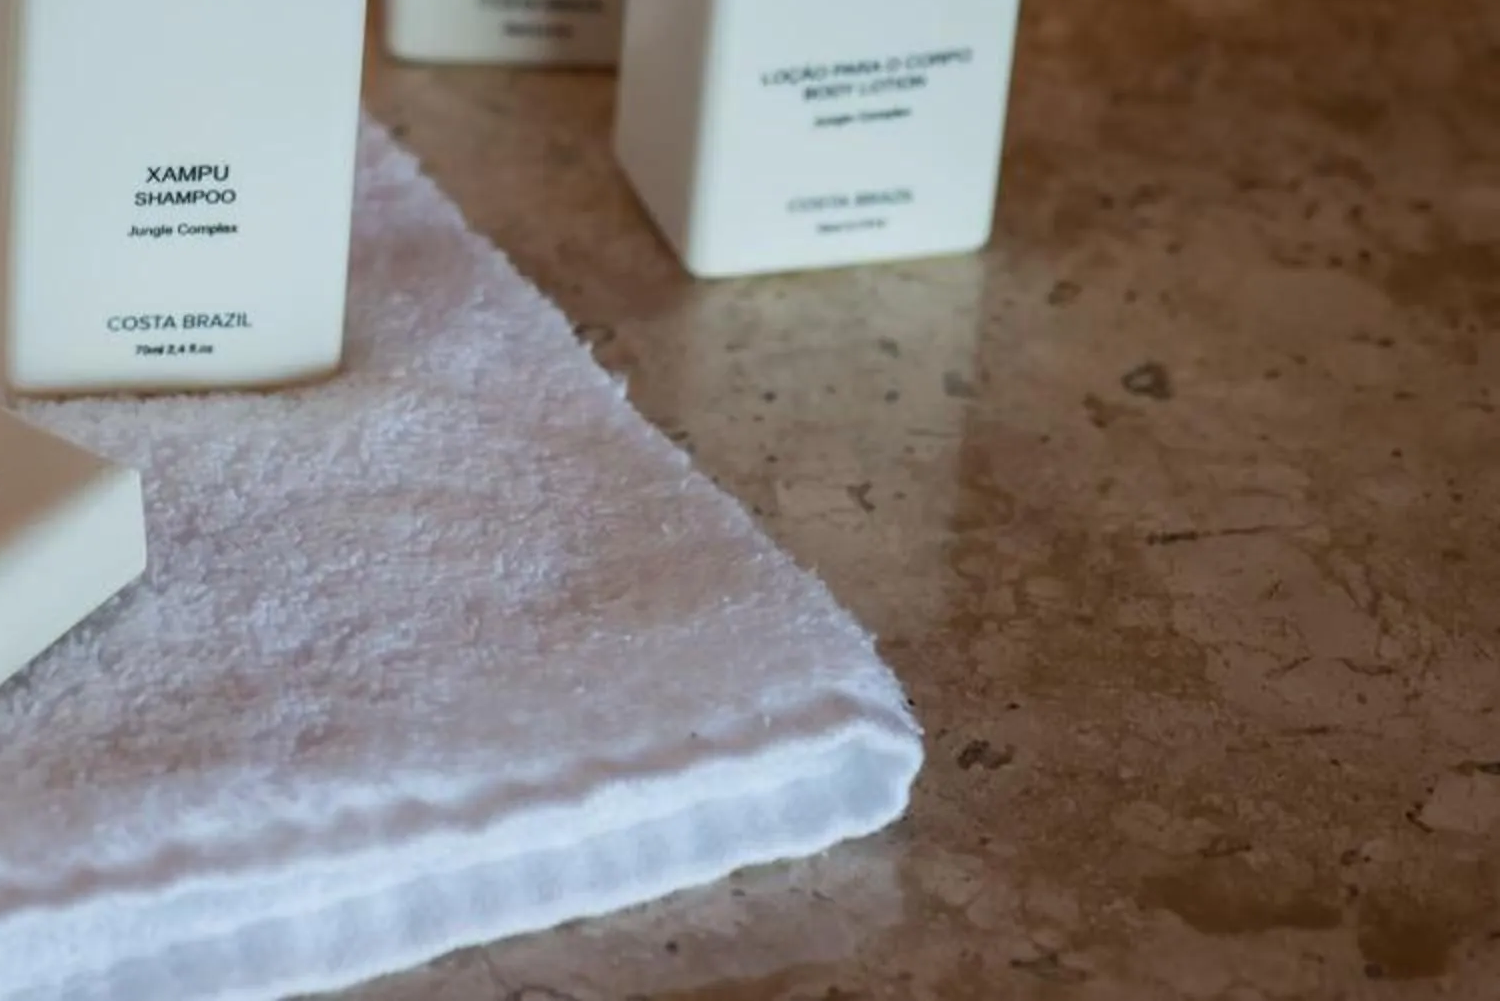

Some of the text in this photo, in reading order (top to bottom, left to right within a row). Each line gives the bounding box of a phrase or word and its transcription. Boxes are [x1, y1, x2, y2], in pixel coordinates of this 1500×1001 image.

[145, 165, 230, 183] XAMPU
[134, 189, 237, 207] SHAMPOO
[127, 223, 238, 238] Jungle Complex
[106, 312, 252, 332] COSTA BRAZIL
